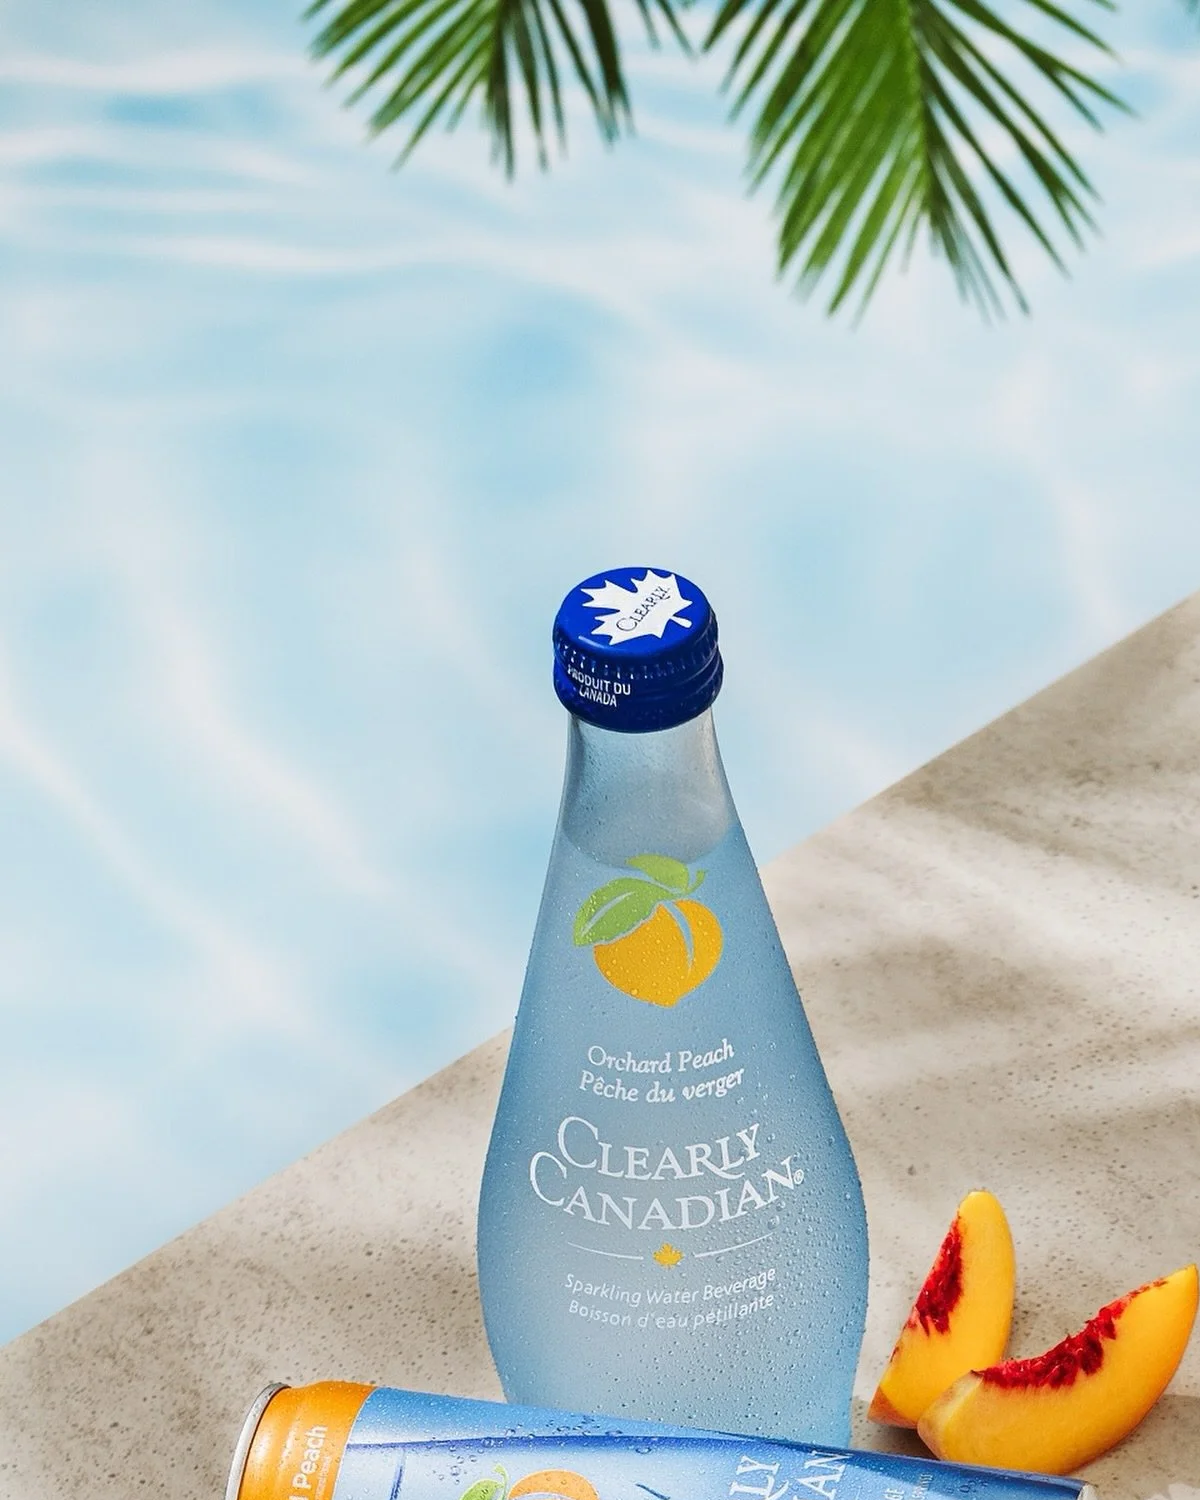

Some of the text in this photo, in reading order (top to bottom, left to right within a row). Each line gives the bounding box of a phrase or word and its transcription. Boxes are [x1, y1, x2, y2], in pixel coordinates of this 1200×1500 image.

[616, 586, 671, 631] CLEARLY
[567, 664, 631, 695] PRODUIT DU
[578, 685, 617, 707] CANADA
[587, 1038, 734, 1073] Orchard Peach
[578, 1067, 745, 1103] Pêche du verger
[557, 1116, 761, 1180] CLEARLY
[564, 1267, 776, 1307] Sparkling Water Beverage
[568, 1292, 775, 1330] Boisson d'eau pétillante
[292, 1425, 328, 1489] Peach
